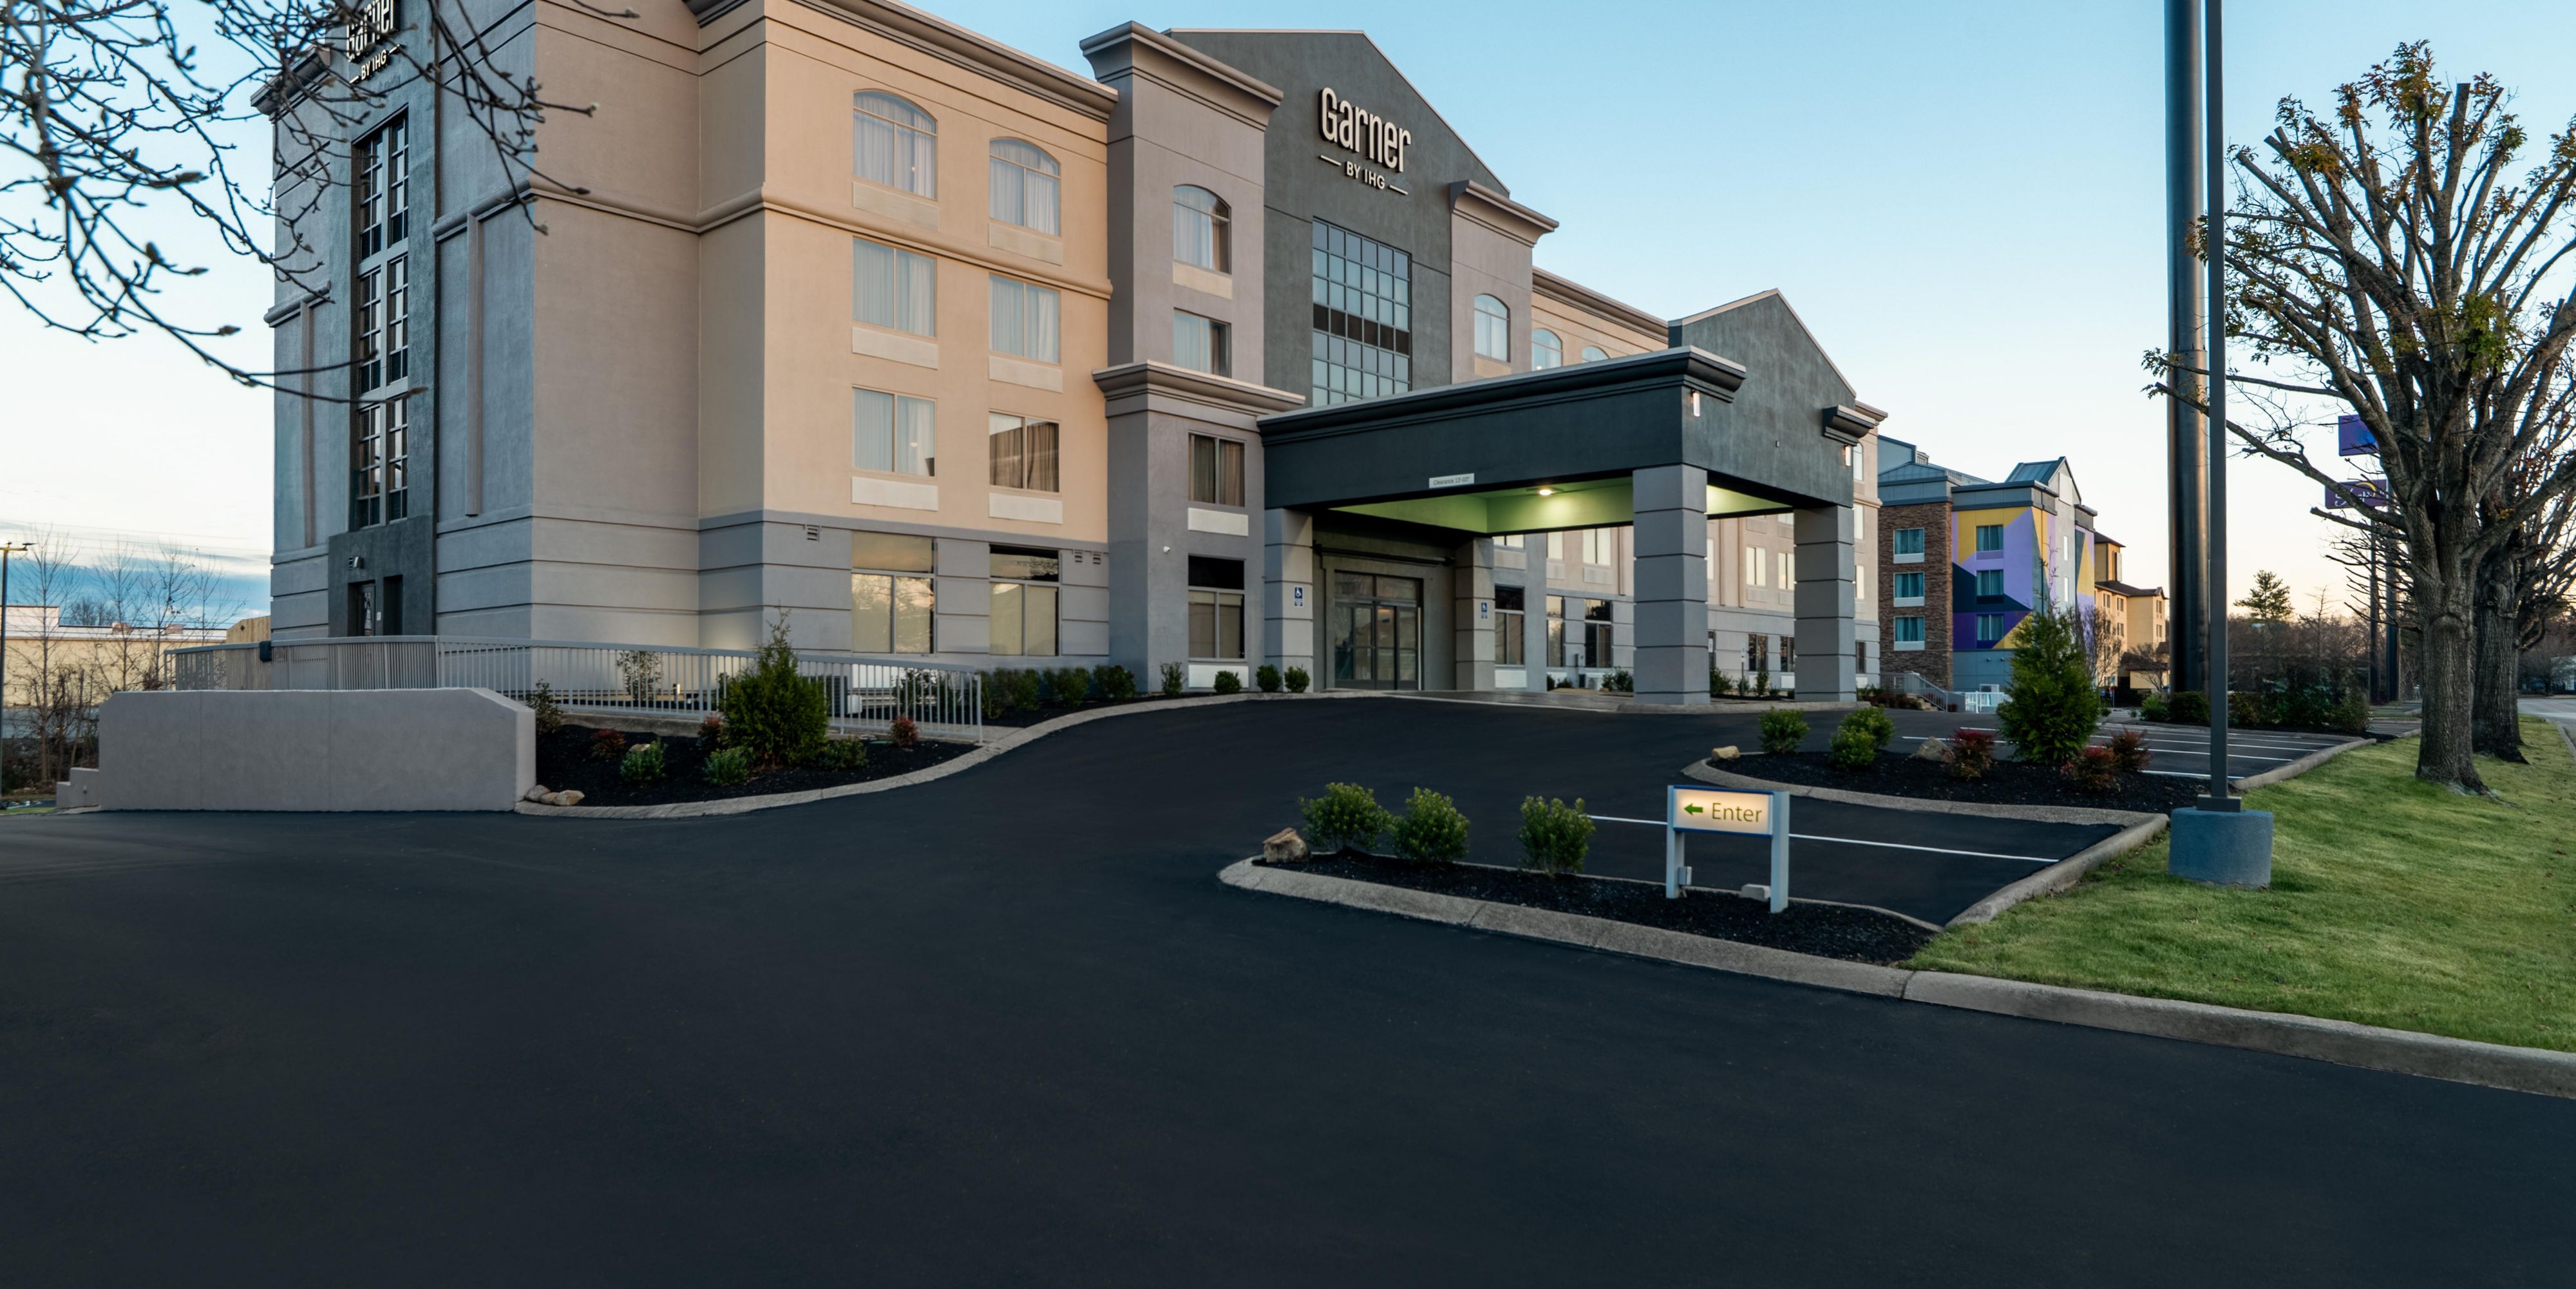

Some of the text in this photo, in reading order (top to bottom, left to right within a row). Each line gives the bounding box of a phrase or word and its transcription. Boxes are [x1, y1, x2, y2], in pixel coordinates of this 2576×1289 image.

[361, 49, 386, 80] BY IHG
[1321, 87, 1412, 172] Garner
[1347, 161, 1385, 189] BY IHG
[1712, 802, 1762, 823] Enter
